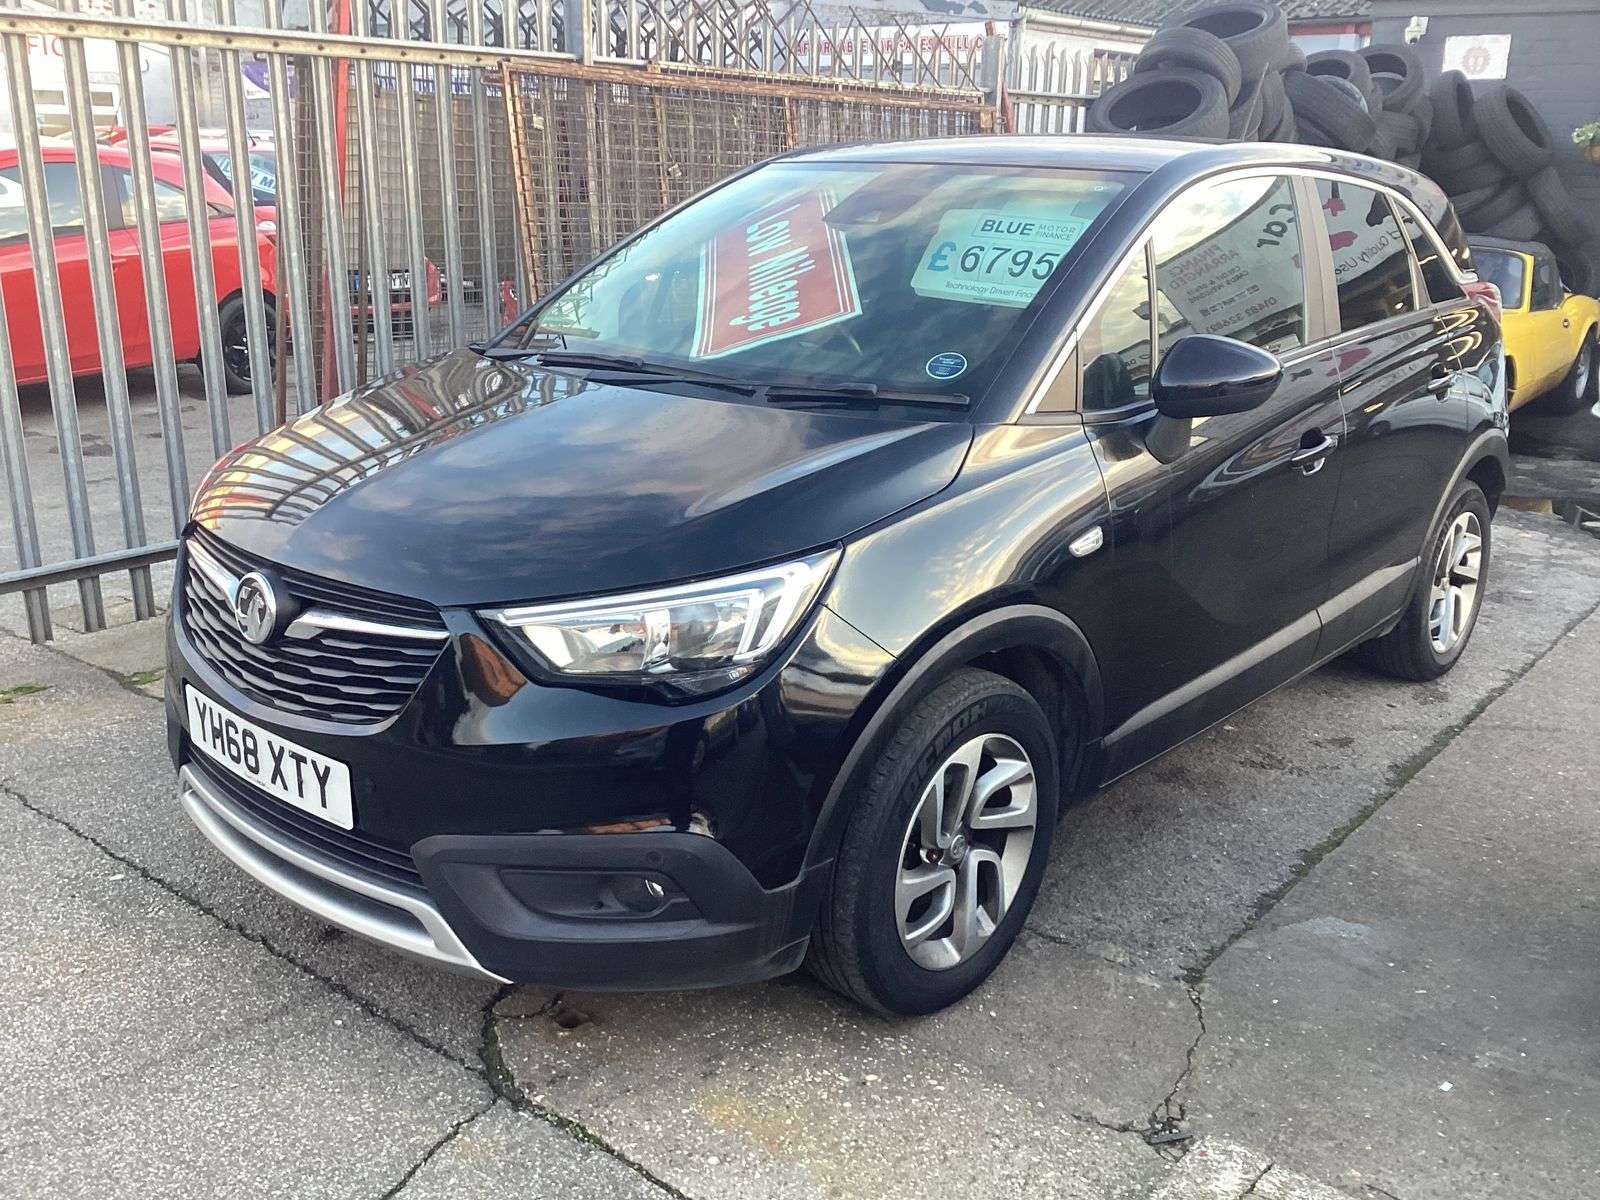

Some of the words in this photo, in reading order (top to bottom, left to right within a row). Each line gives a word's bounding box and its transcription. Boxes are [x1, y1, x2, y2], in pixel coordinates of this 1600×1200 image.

[746, 203, 800, 257] Low
[980, 219, 1035, 236] BLUE
[1038, 223, 1077, 233] MOTOR
[728, 246, 816, 331] Mileage
[945, 280, 989, 296] Technology
[990, 286, 1015, 297] Driven
[195, 696, 260, 775] YH68
[267, 740, 331, 809] XTY
